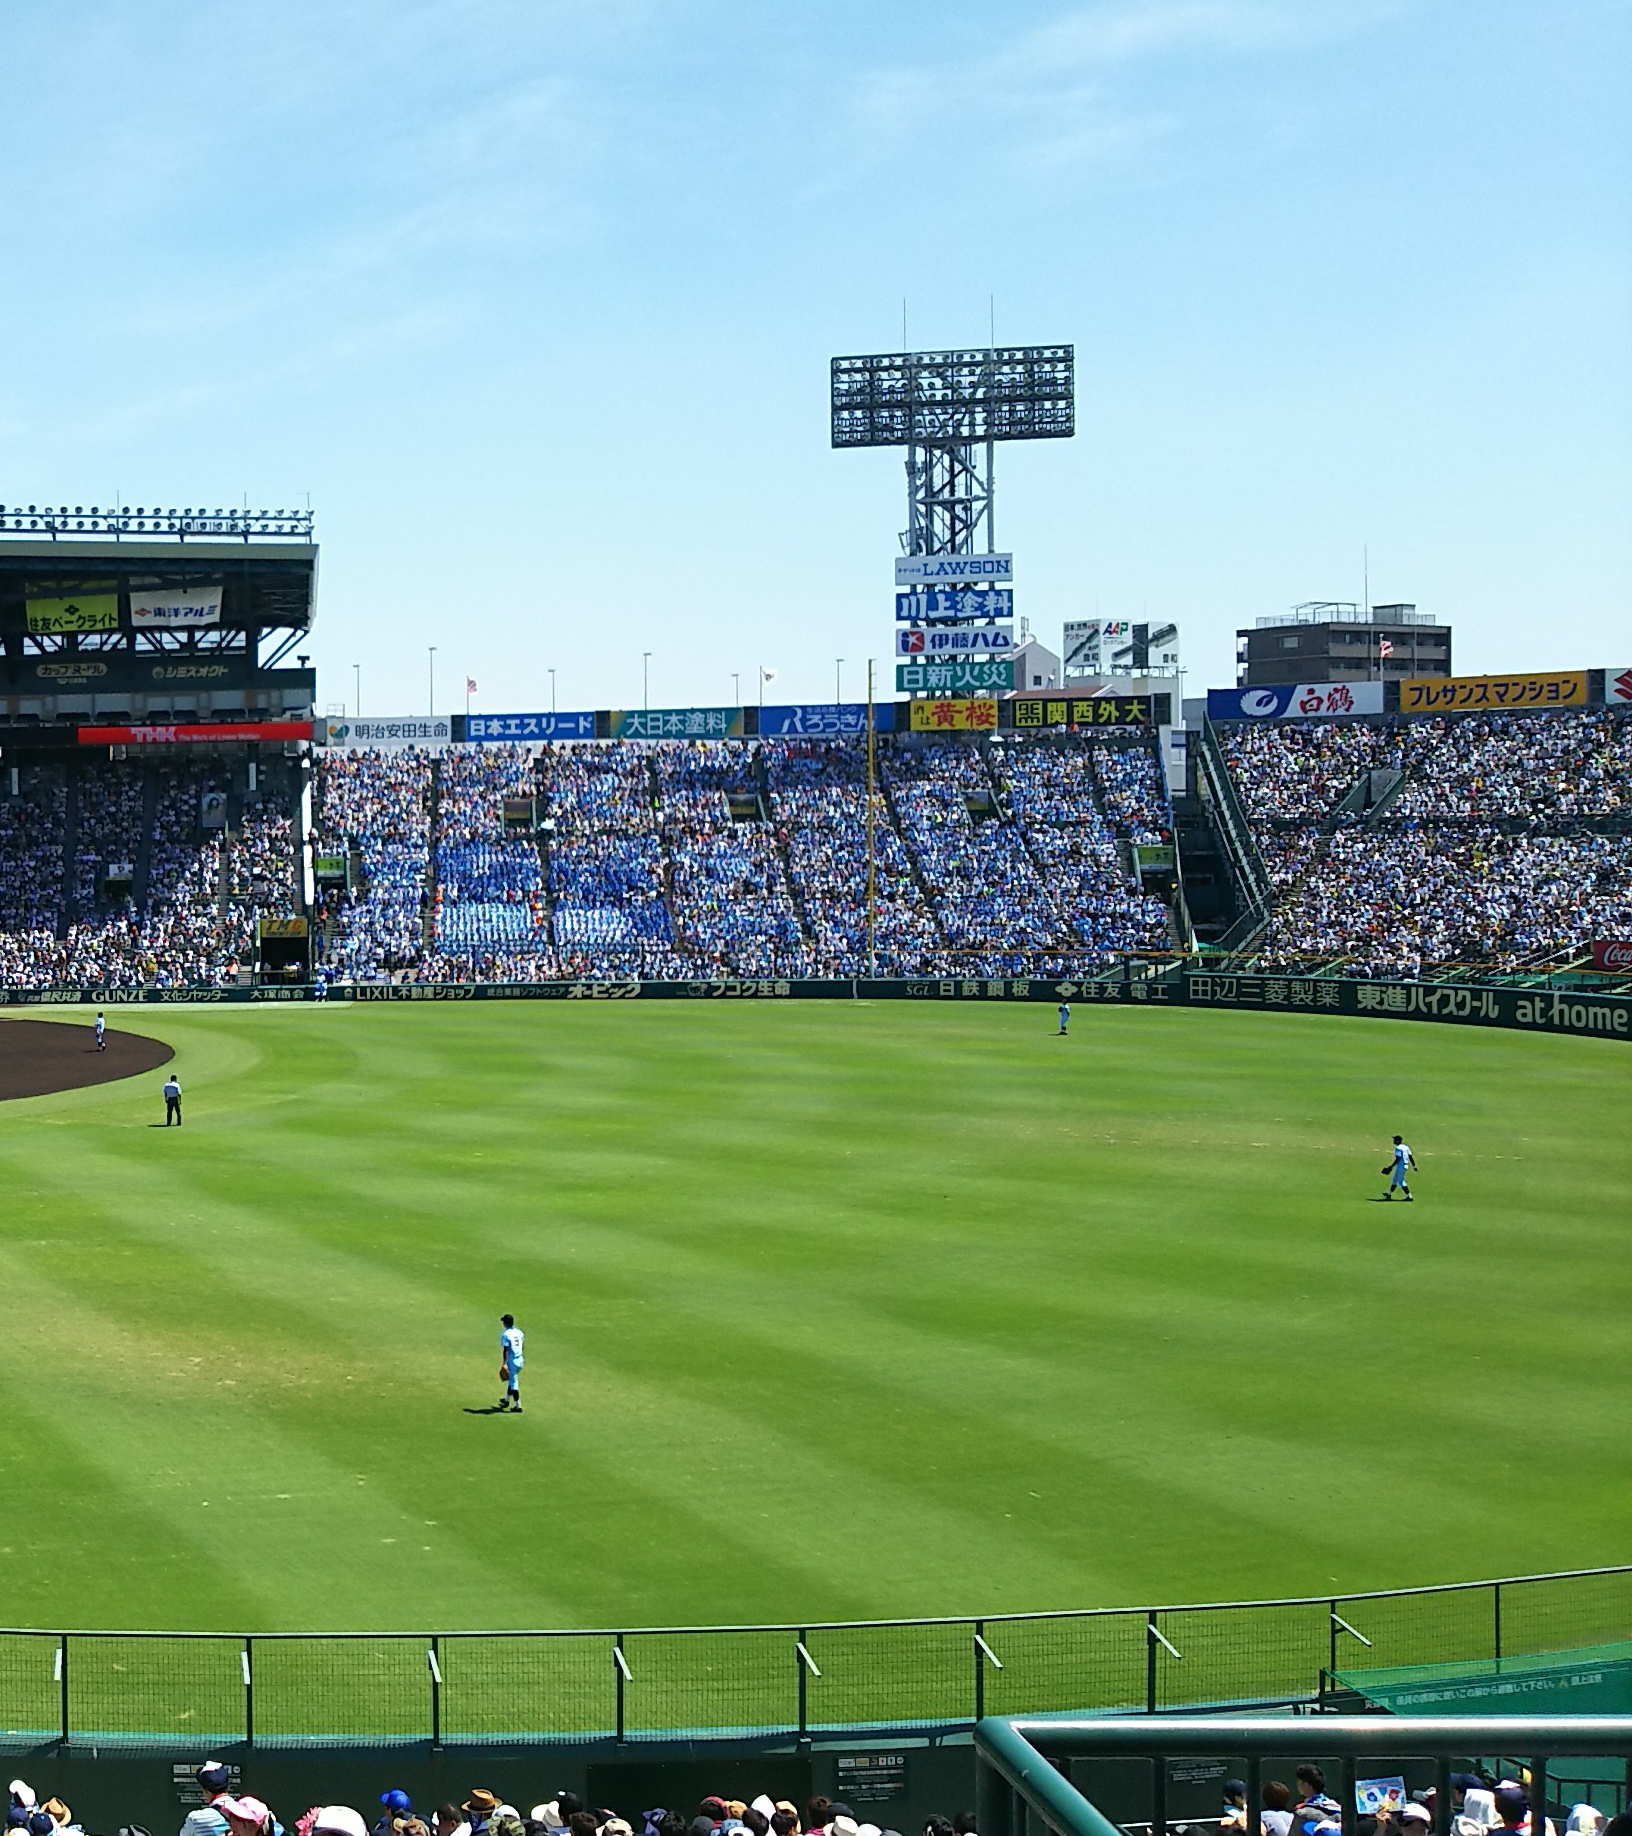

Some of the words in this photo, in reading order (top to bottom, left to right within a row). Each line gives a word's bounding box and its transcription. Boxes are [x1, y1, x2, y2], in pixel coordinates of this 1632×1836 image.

[923, 559, 1010, 576] LAWSON
[153, 605, 219, 618] 東洋アルミ
[900, 591, 1012, 619] 川上塗料
[29, 613, 117, 632] 住友ベークライト
[1103, 622, 1128, 635] AAP
[930, 632, 1010, 649] 伊藤ハム
[165, 665, 229, 677] シミズオクト
[903, 665, 1007, 688] 日新火災
[1298, 685, 1354, 714] 白鶴
[1408, 679, 1579, 707] プレサンスマンション
[931, 701, 996, 728] 黄桜
[1046, 701, 1147, 723] 関西外大
[355, 722, 449, 740] 明治安田生命
[470, 716, 593, 737] 日本エスリード
[626, 711, 728, 735] 大日本塗料
[805, 713, 875, 732] ろうきん
[130, 727, 176, 742] THK
[91, 989, 148, 1002] GUNZE
[355, 984, 475, 1000] LIXIL不動産ショップ
[567, 983, 641, 998] オービック
[710, 980, 791, 997] フコク生命
[905, 984, 930, 996] SGL
[939, 980, 1031, 997] 日鉄鋼板
[1080, 981, 1168, 999] 住友電工
[1189, 977, 1340, 1007] 田辺三菱製薬
[1357, 984, 1500, 1019] 東進ハイスクール
[1516, 996, 1544, 1024] at
[1548, 992, 1629, 1033] home
